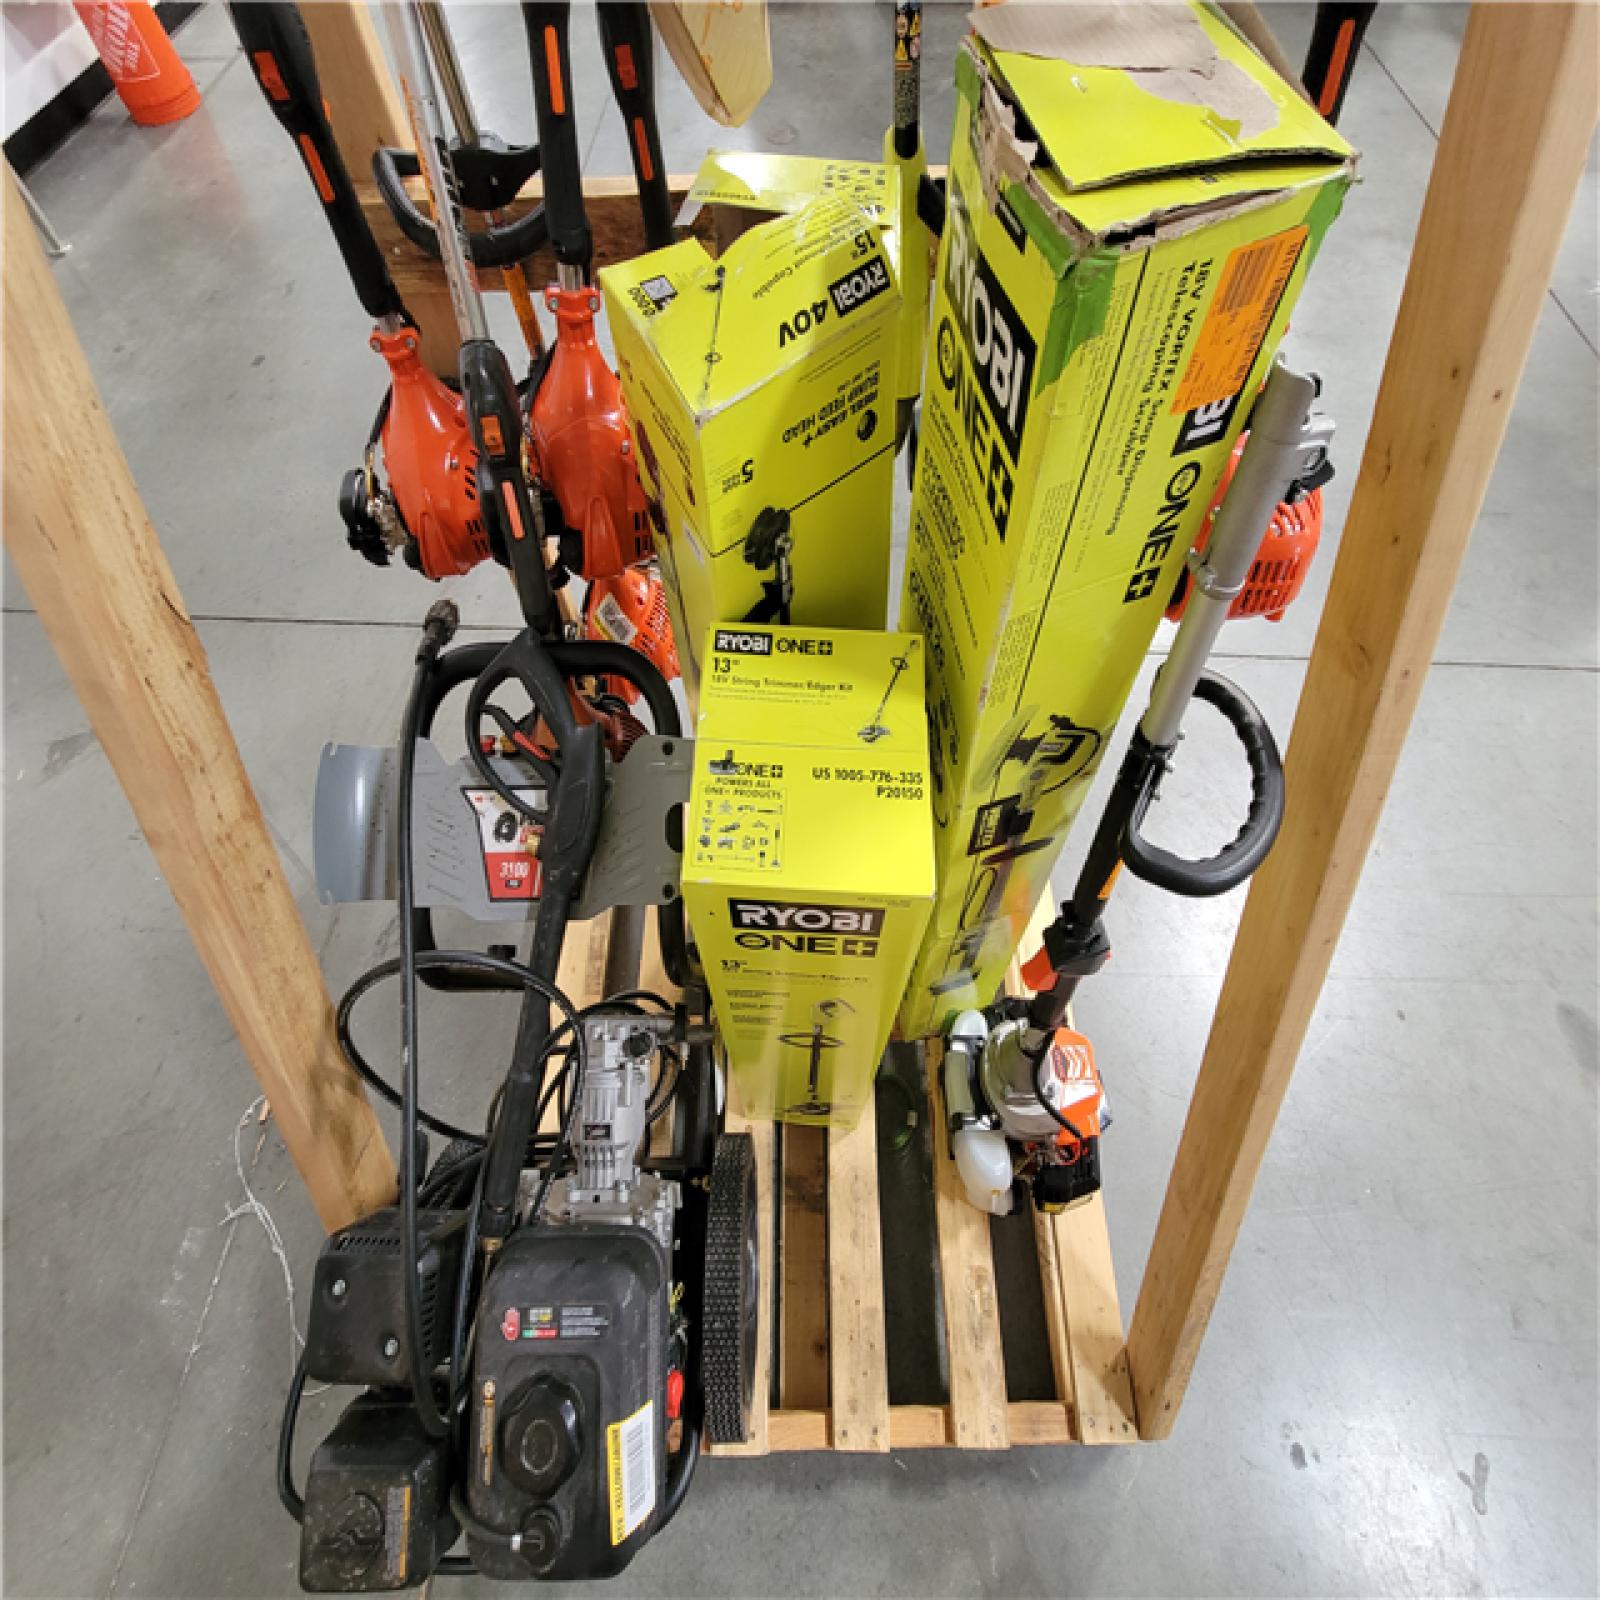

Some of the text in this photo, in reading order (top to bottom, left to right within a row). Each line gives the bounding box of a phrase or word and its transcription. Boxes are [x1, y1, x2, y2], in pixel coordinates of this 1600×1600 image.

[778, 257, 889, 348] RYOBI 40V
[949, 224, 1029, 440] RYOBI
[1142, 262, 1197, 394] Telescoping
[1160, 308, 1198, 392] VORTEX
[783, 414, 816, 443] HEAD
[1140, 398, 1165, 445] Soap
[1116, 398, 1152, 477] Scrubber
[741, 458, 755, 485] 5
[717, 632, 770, 654] RYOBI
[713, 656, 740, 674] 13"
[732, 674, 761, 688] String
[838, 682, 854, 692] Kit
[755, 779, 771, 789] ALL
[812, 766, 924, 785] US 1005-776-335
[733, 788, 782, 801] PRODUCTS
[876, 785, 924, 801] P20150
[500, 861, 530, 880] 3100
[733, 902, 876, 933] RYOBI
